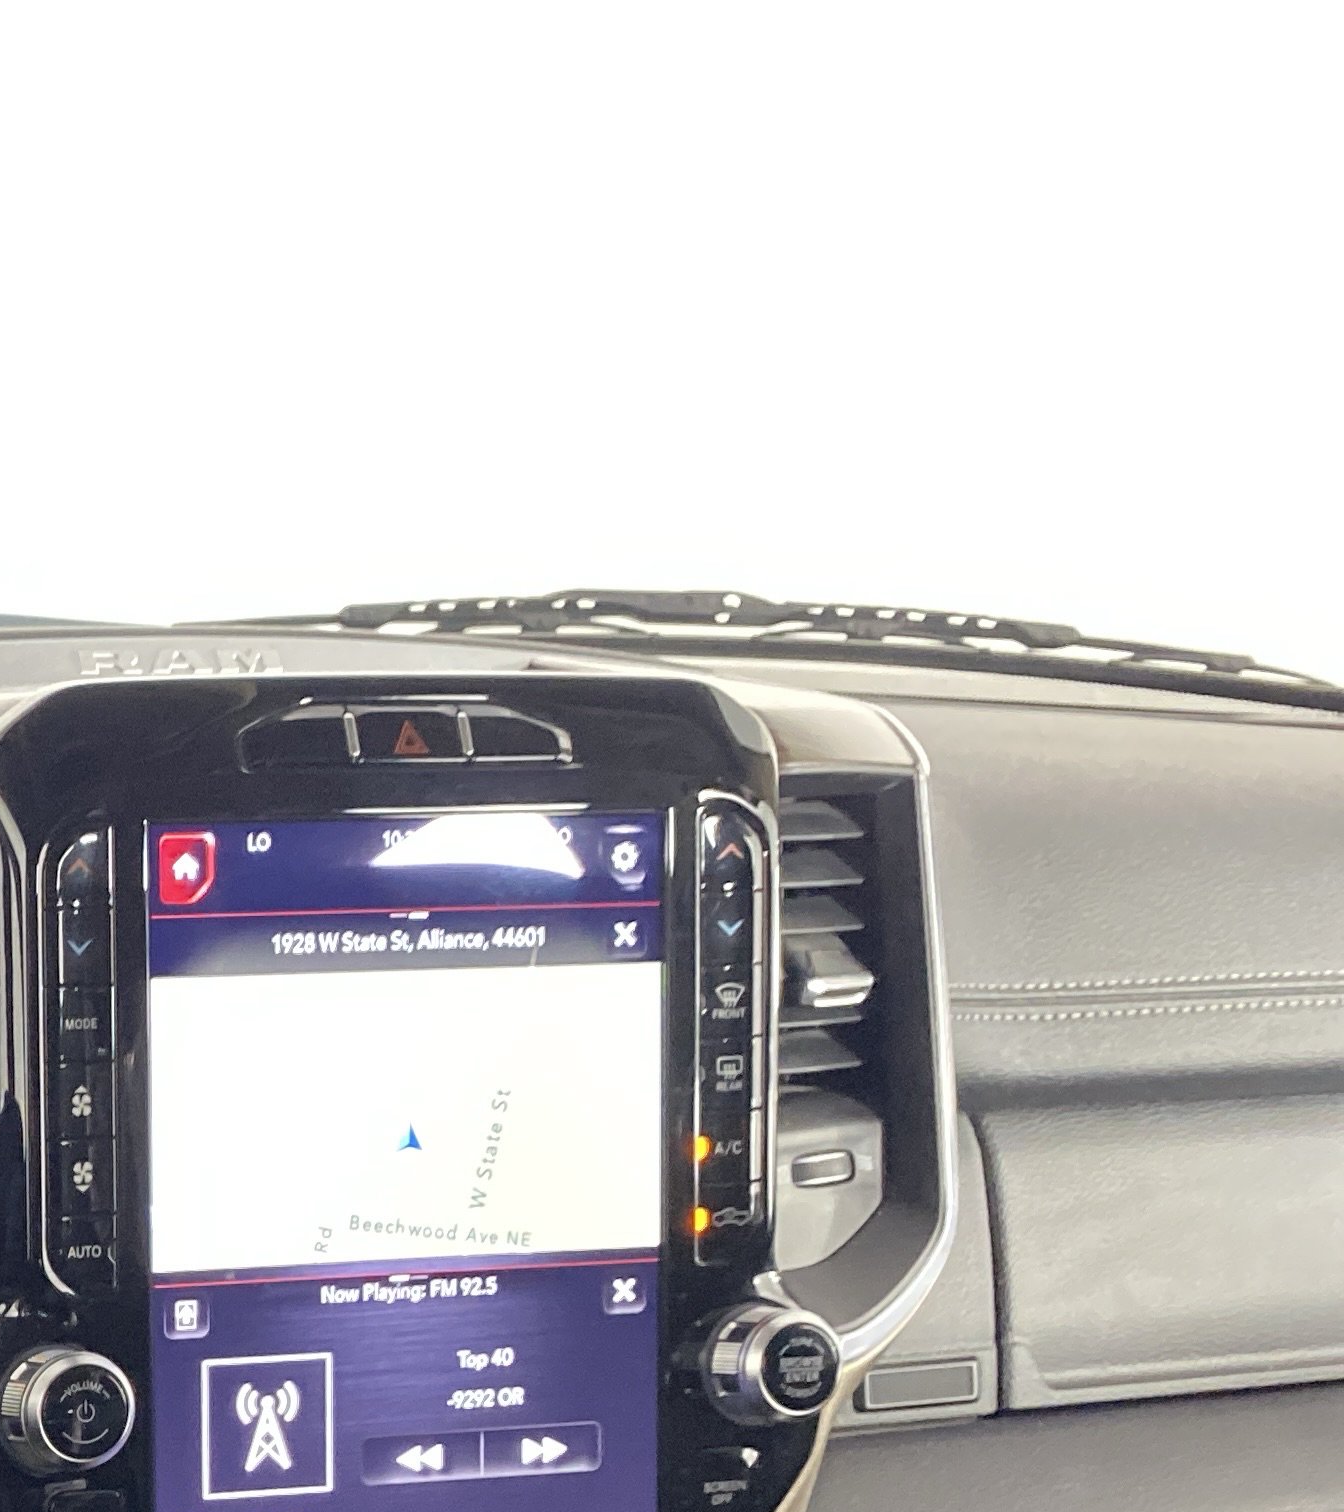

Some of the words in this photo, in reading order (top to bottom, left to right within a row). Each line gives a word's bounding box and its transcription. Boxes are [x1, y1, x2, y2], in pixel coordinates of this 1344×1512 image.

[75, 649, 285, 675] RAM
[246, 832, 272, 852] LO
[271, 932, 315, 954] 1928
[320, 932, 340, 952] W
[341, 930, 387, 953] State
[390, 929, 413, 954] St,
[416, 928, 489, 952] Alliance,
[492, 925, 546, 949] 44601
[65, 1017, 98, 1030] MODE
[476, 1121, 503, 1181] State
[714, 1140, 743, 1155] A/C
[469, 1187, 488, 1209] W
[349, 1214, 458, 1240] Beechwood
[466, 1227, 498, 1245] Ave
[506, 1230, 532, 1247] NE
[67, 1244, 102, 1259] AUTO
[320, 1285, 359, 1304] Now
[363, 1281, 426, 1304] Playing:
[429, 1277, 458, 1298] FM
[460, 1275, 499, 1296] 92.5
[456, 1349, 489, 1371] Top
[491, 1347, 515, 1366] 40
[63, 1379, 104, 1397] VOLUME
[497, 1386, 525, 1407] OR
